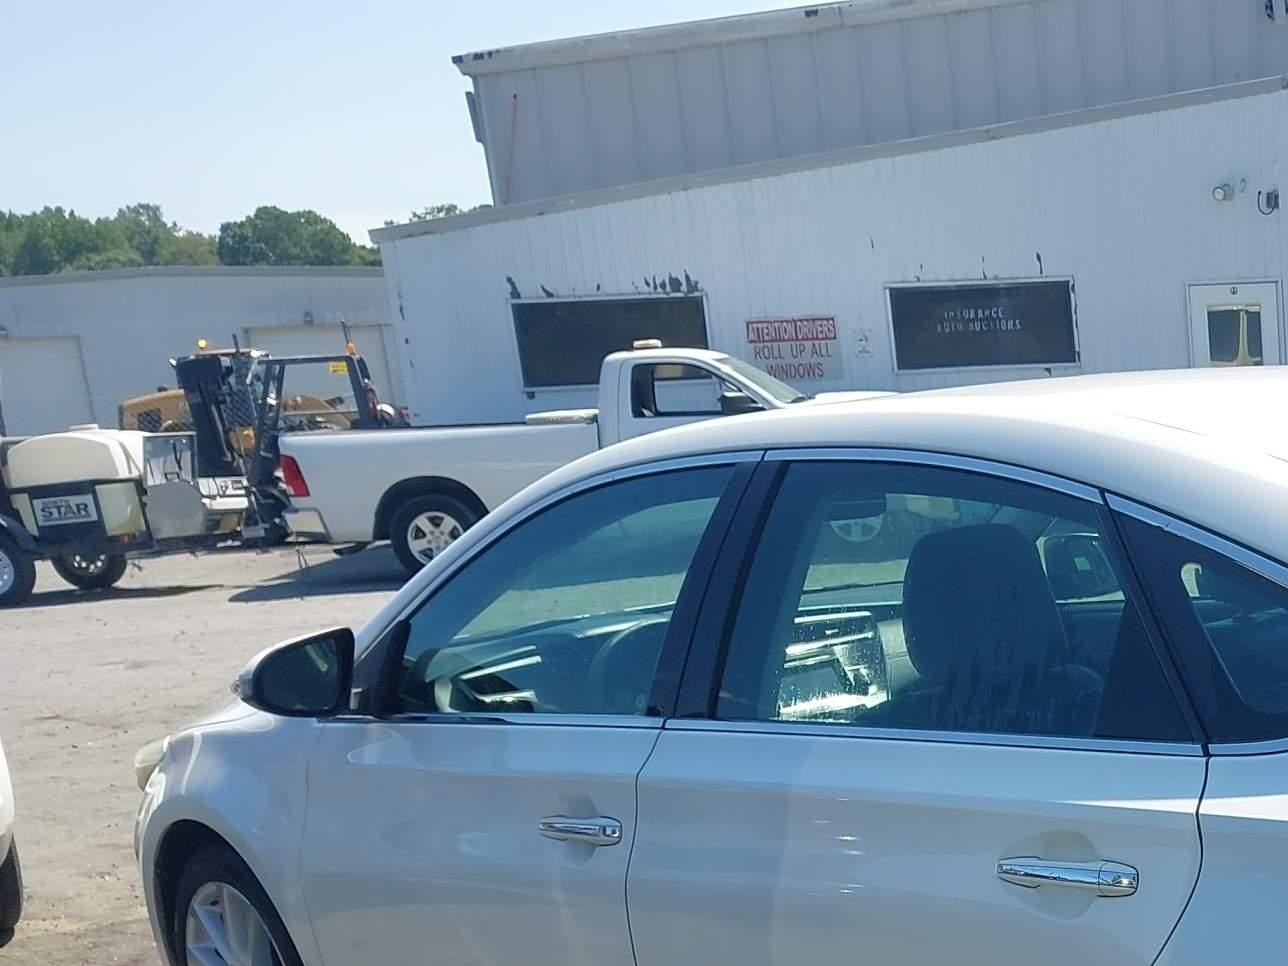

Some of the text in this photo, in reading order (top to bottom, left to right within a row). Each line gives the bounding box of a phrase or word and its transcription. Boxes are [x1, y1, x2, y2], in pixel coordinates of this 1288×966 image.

[748, 319, 835, 341] ATTENTION DRIVERS
[753, 342, 832, 360] ROLL UP ALL
[766, 362, 824, 378] WINDOWS
[41, 503, 90, 518] STAR
